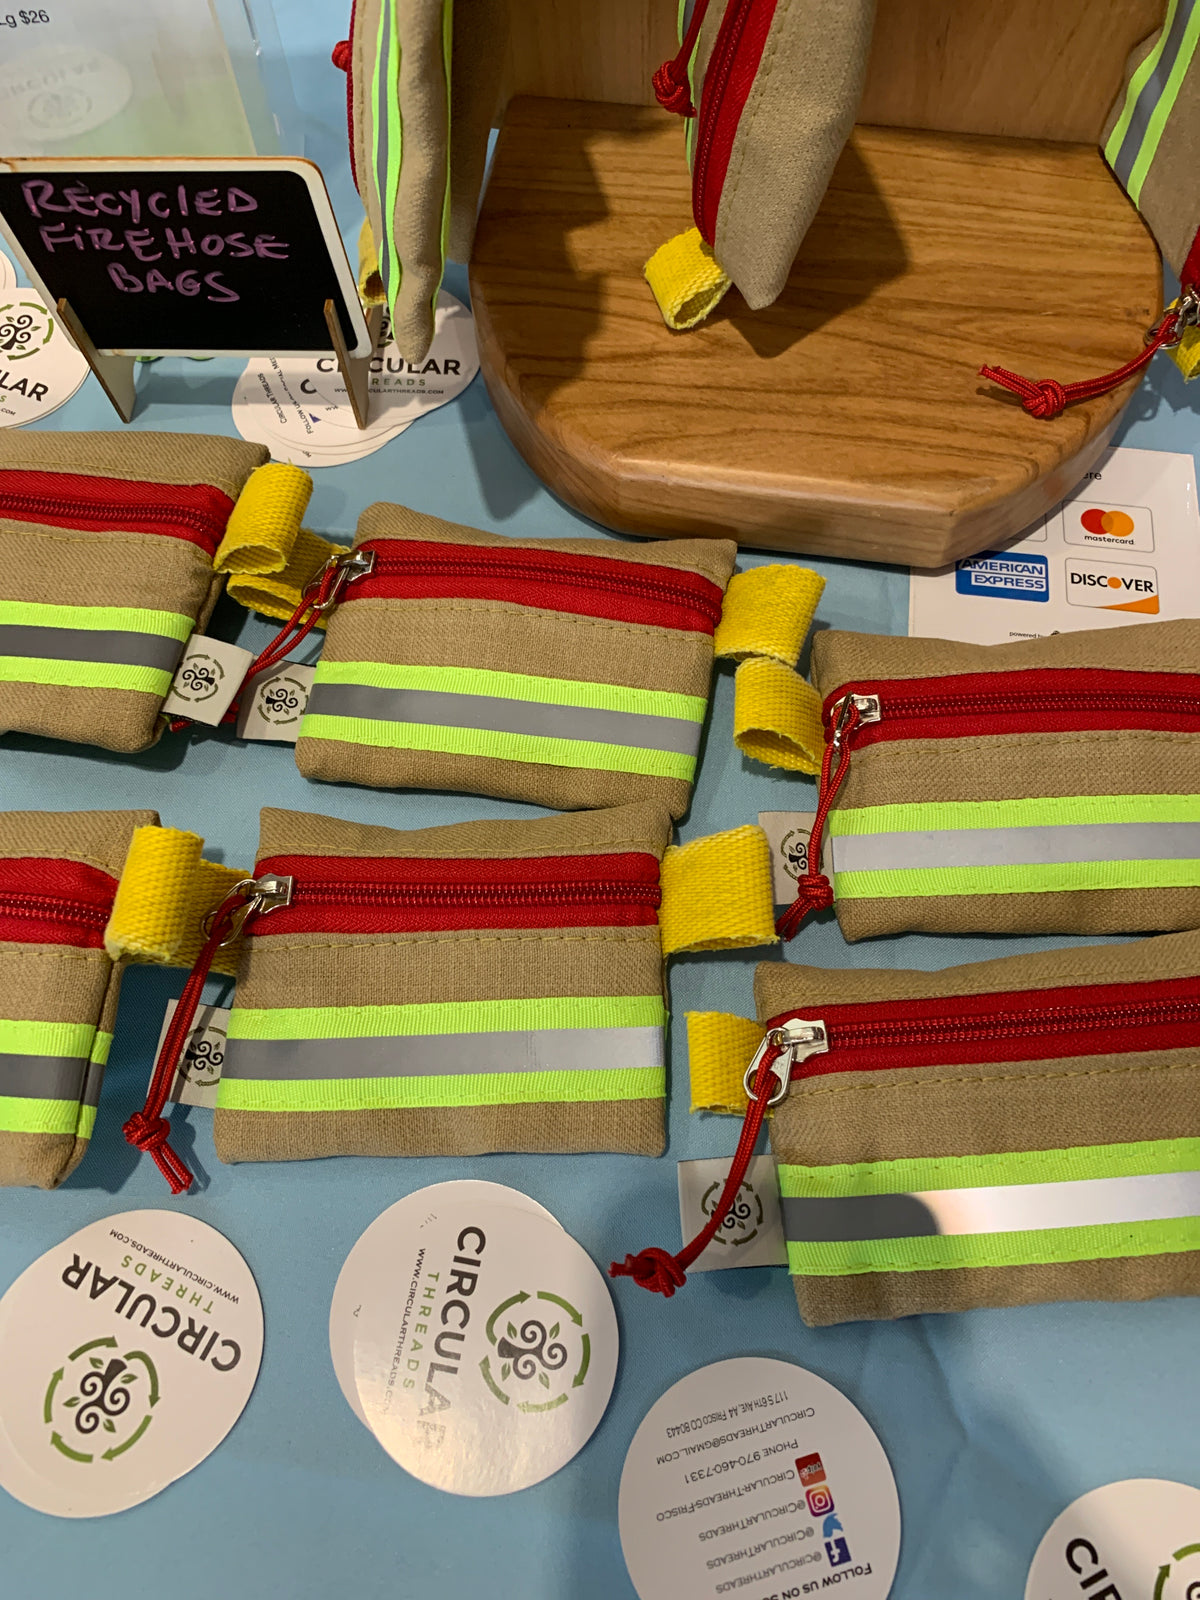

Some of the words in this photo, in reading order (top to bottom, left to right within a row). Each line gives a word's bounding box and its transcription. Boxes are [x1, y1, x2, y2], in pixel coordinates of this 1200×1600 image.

[19, 9, 50, 25] $26
[21, 179, 258, 224] RECYCLED
[107, 262, 240, 302] BAGS
[1084, 535, 1134, 545] mastercard
[962, 560, 1043, 575] AMERICAN
[974, 574, 1044, 589] EXPRESS
[1070, 573, 1154, 593] DISCOVER
[120, 1255, 214, 1314] THREADS
[61, 1253, 241, 1372] CIRCULAR
[403, 1271, 439, 1389] THREADS
[775, 1391, 788, 1403] 117
[666, 1422, 691, 1438] 80443
[691, 1418, 703, 1430] CO
[684, 1451, 761, 1484] 970-460-7331
[822, 1563, 872, 1588] FOLLOW
[782, 1587, 800, 1600] ON
[802, 1581, 819, 1594] US
